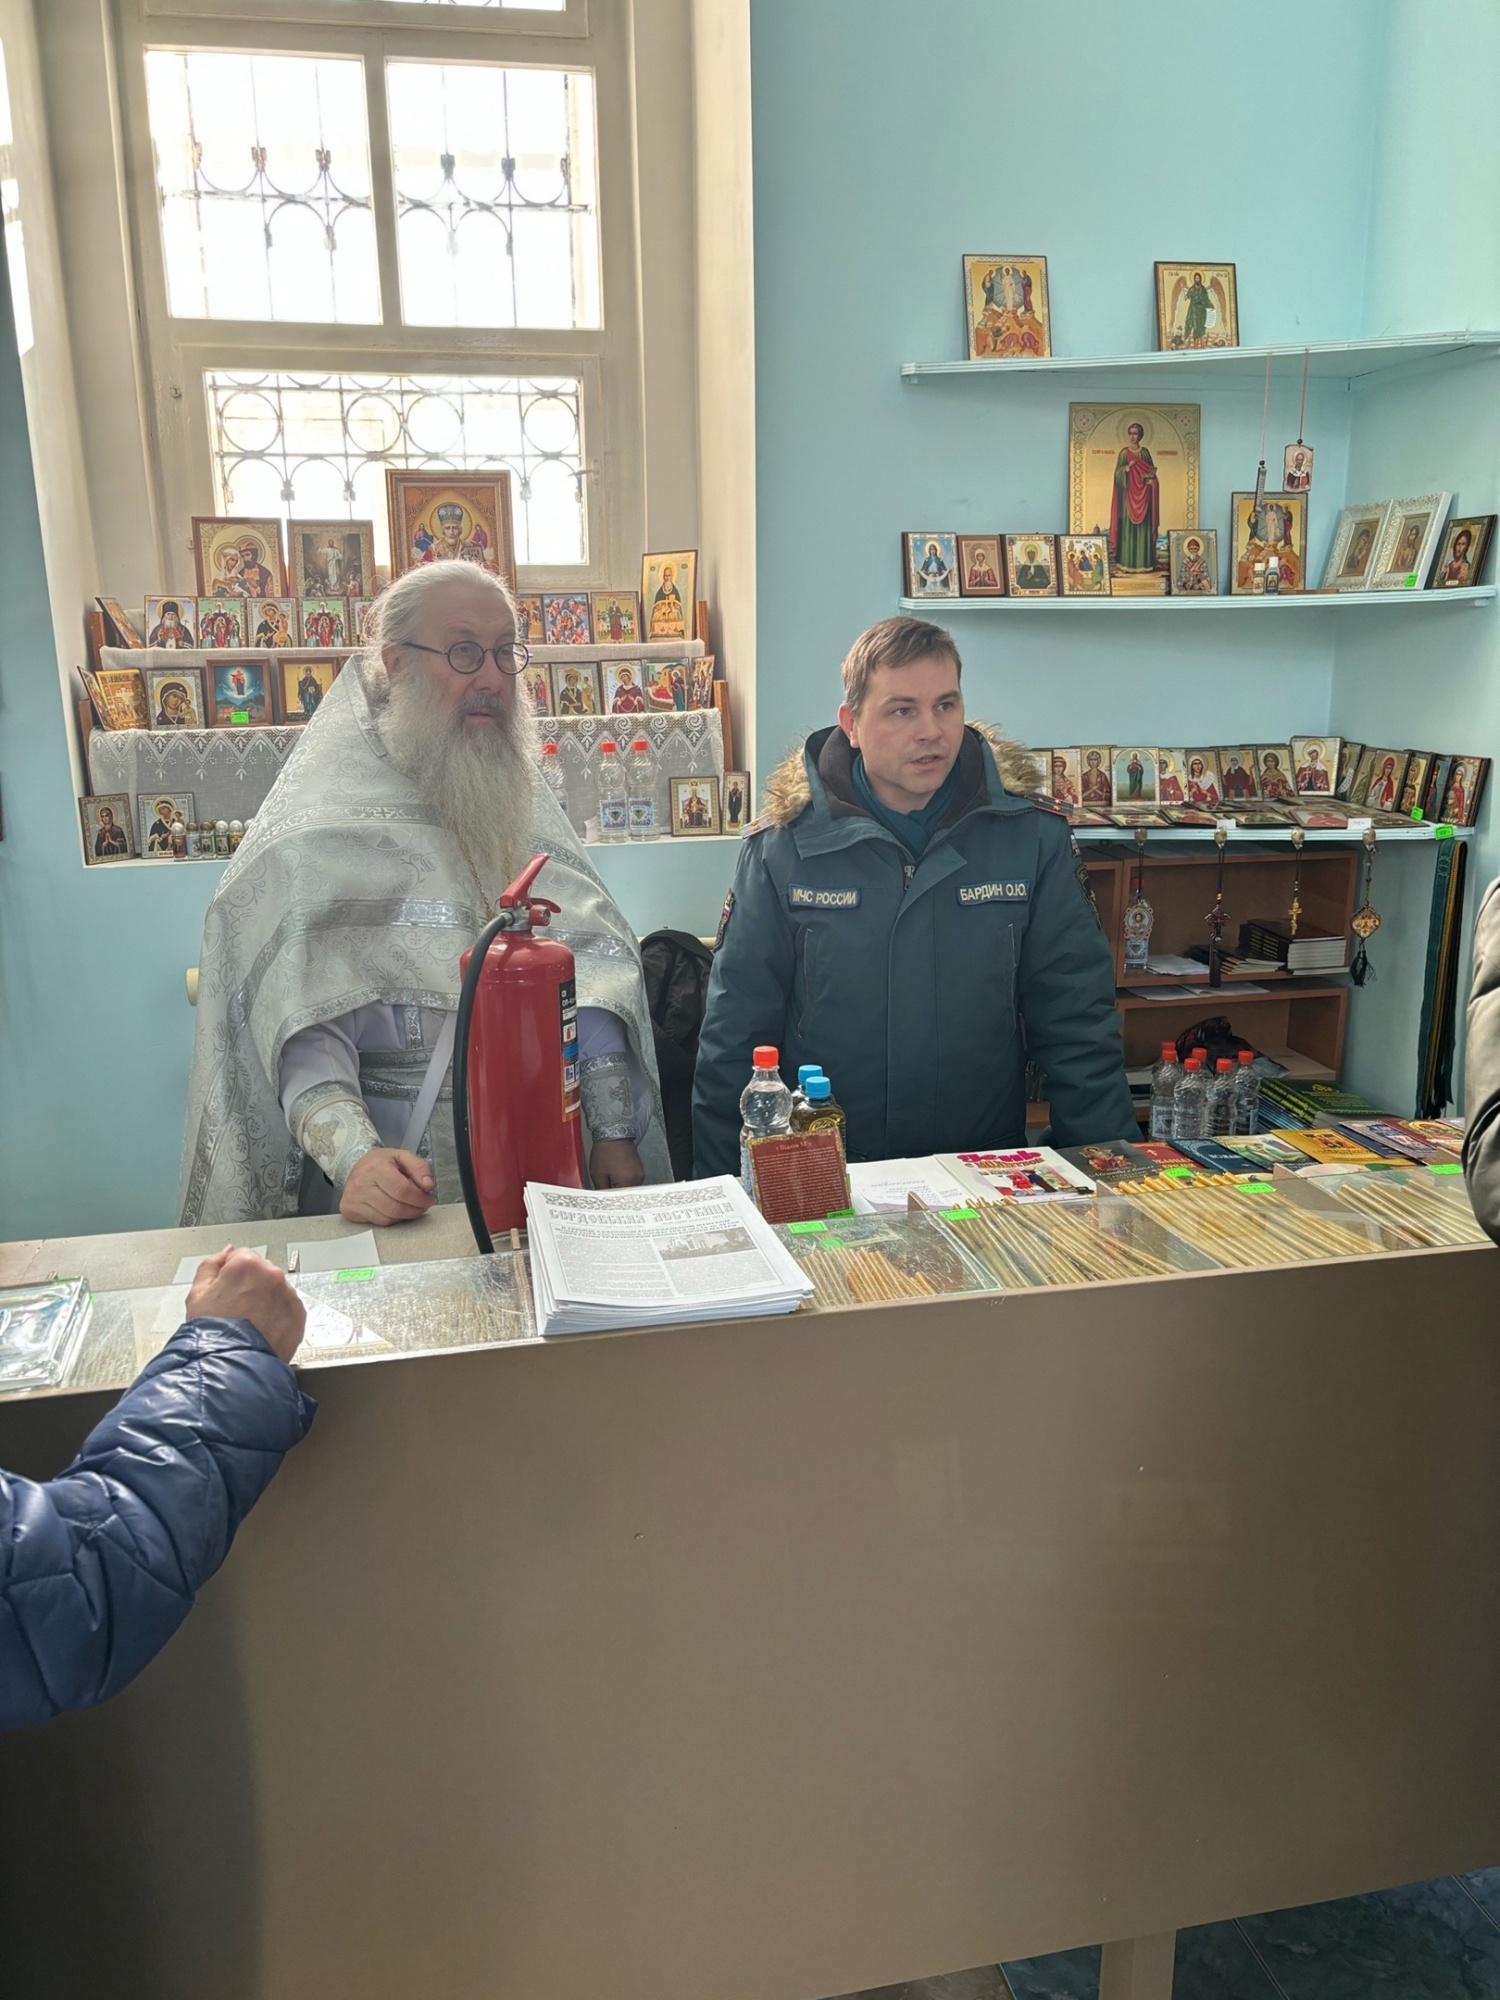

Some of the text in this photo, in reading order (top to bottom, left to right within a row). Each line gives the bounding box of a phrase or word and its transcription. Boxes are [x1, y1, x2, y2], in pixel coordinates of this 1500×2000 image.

[793, 888, 856, 905] МЧС РОССИИ
[960, 883, 1027, 900] БАРДИН О.Ю.
